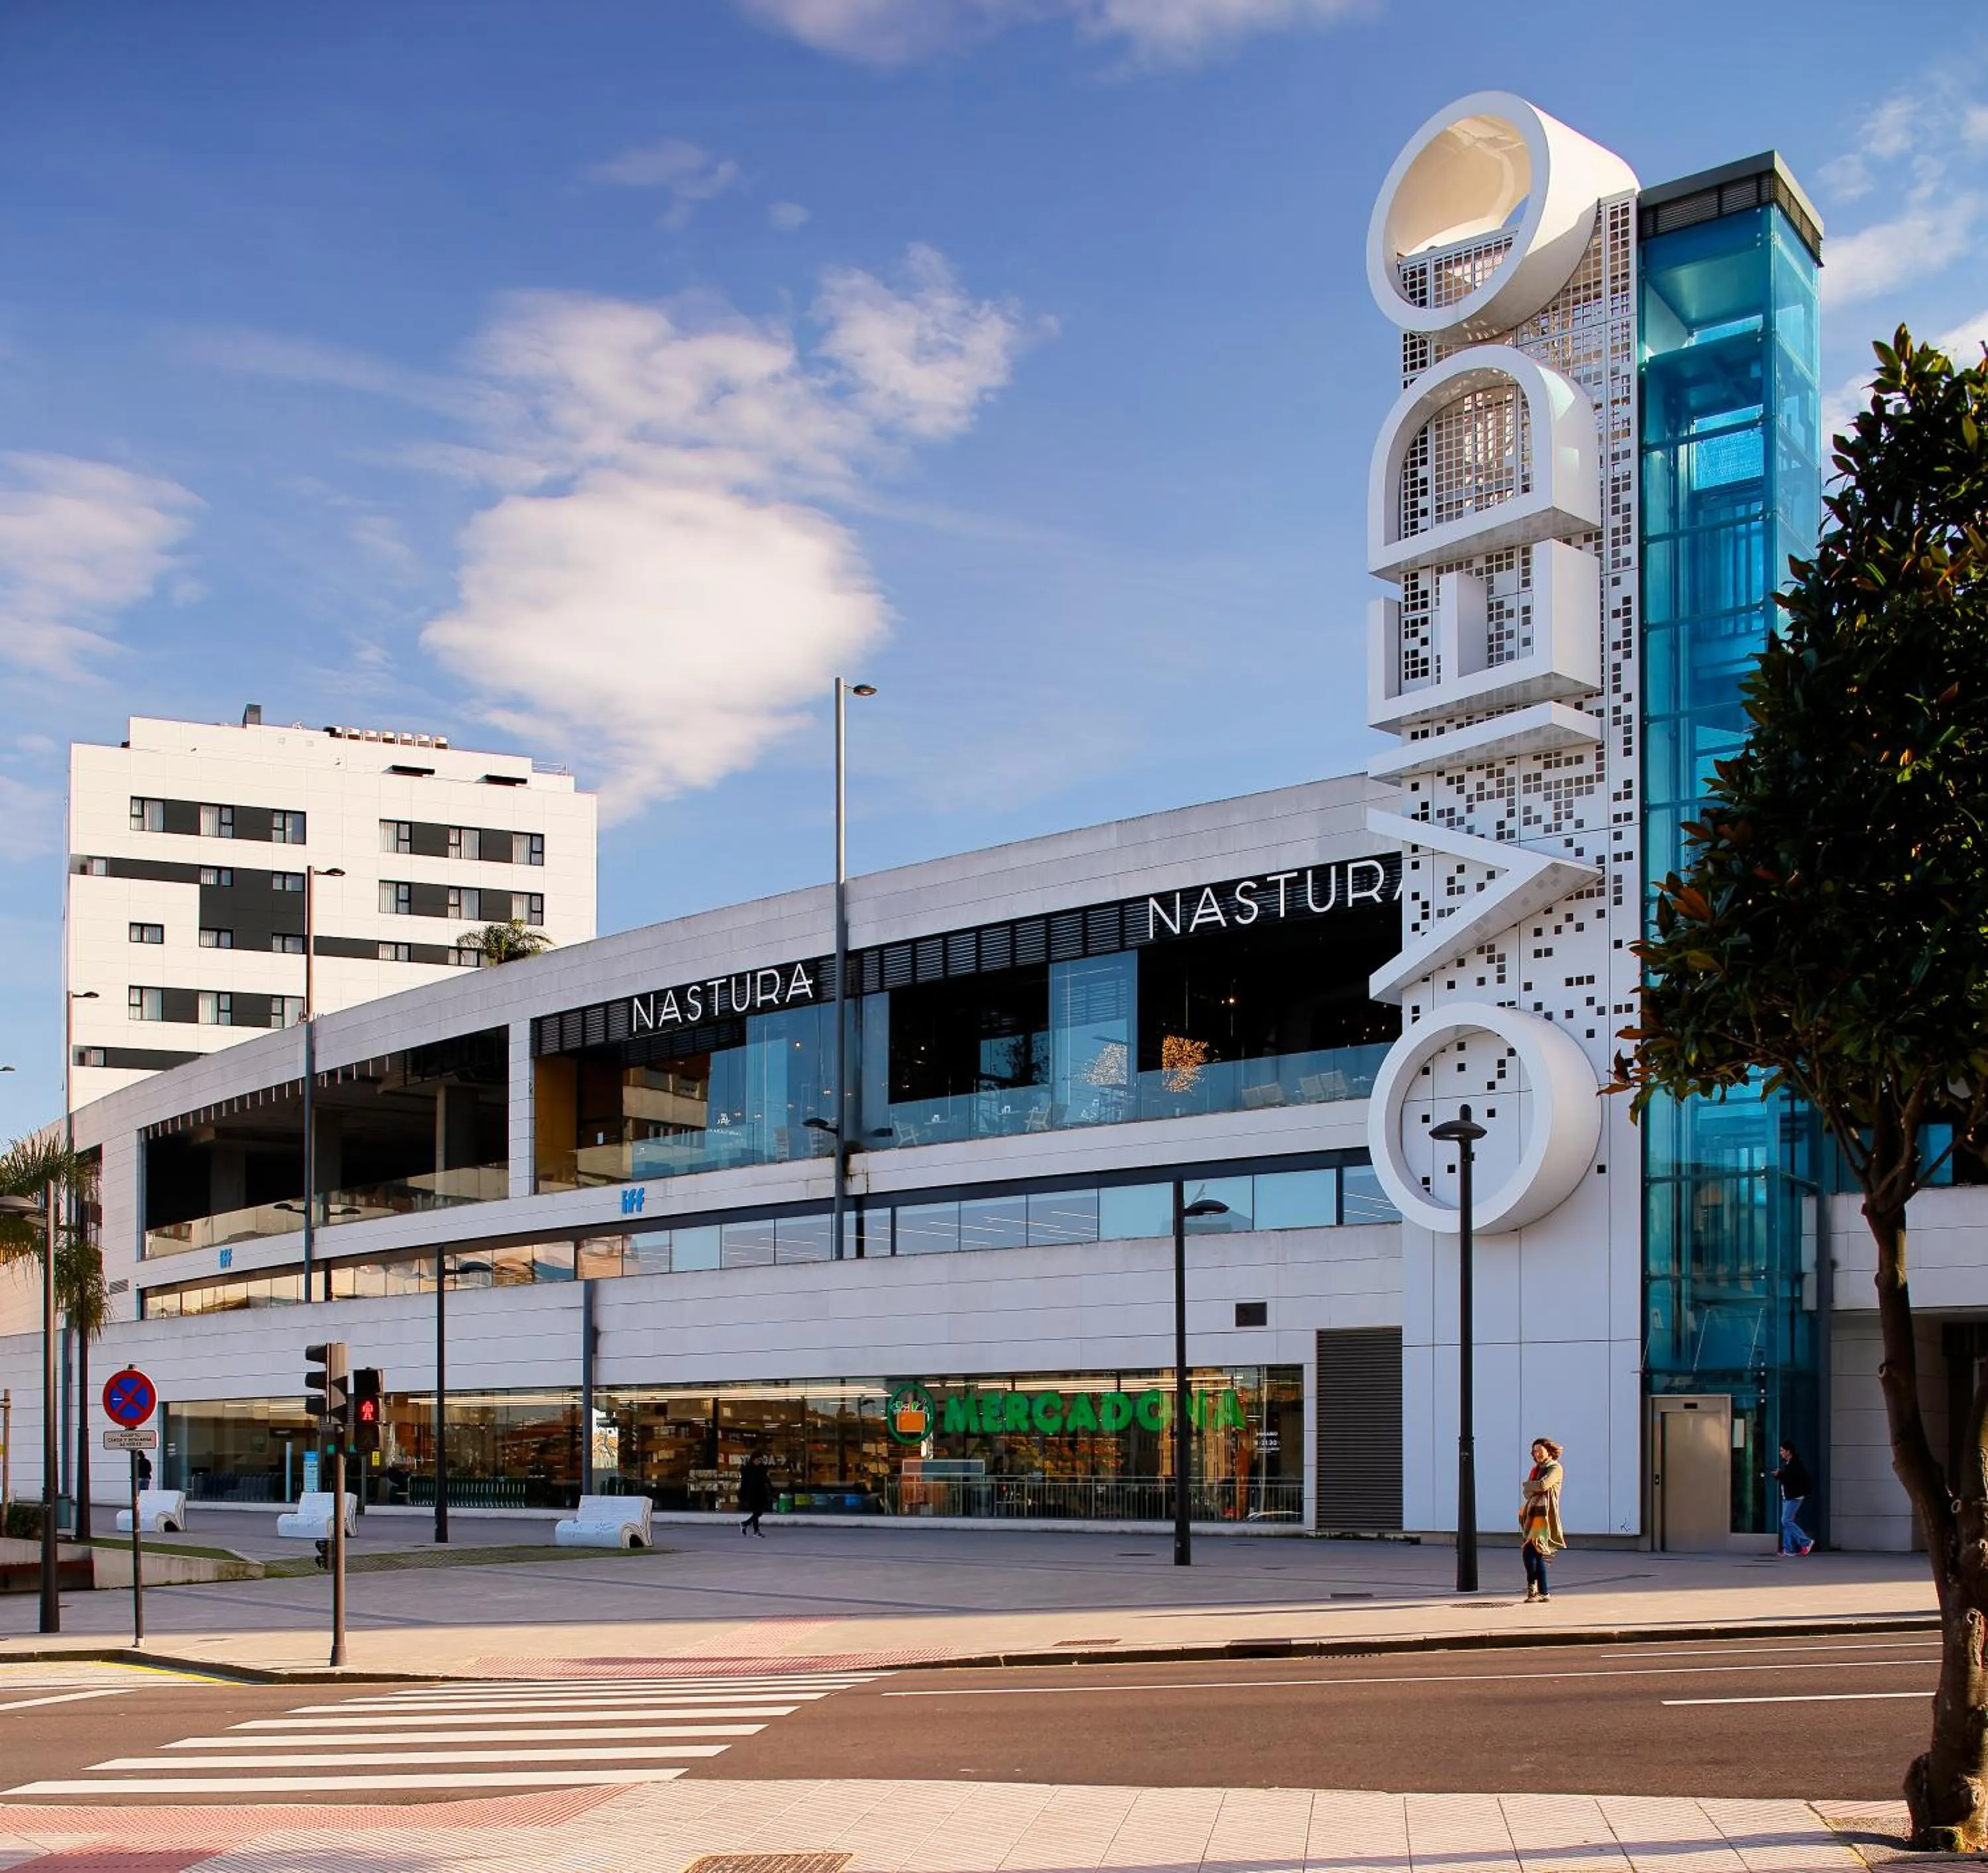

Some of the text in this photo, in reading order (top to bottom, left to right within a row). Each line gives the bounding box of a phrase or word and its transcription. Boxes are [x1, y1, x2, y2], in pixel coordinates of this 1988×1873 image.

[1366, 90, 1604, 1235] OVIEDO
[1148, 859, 1403, 940] NASTUR
[633, 963, 813, 1032] NASTURA
